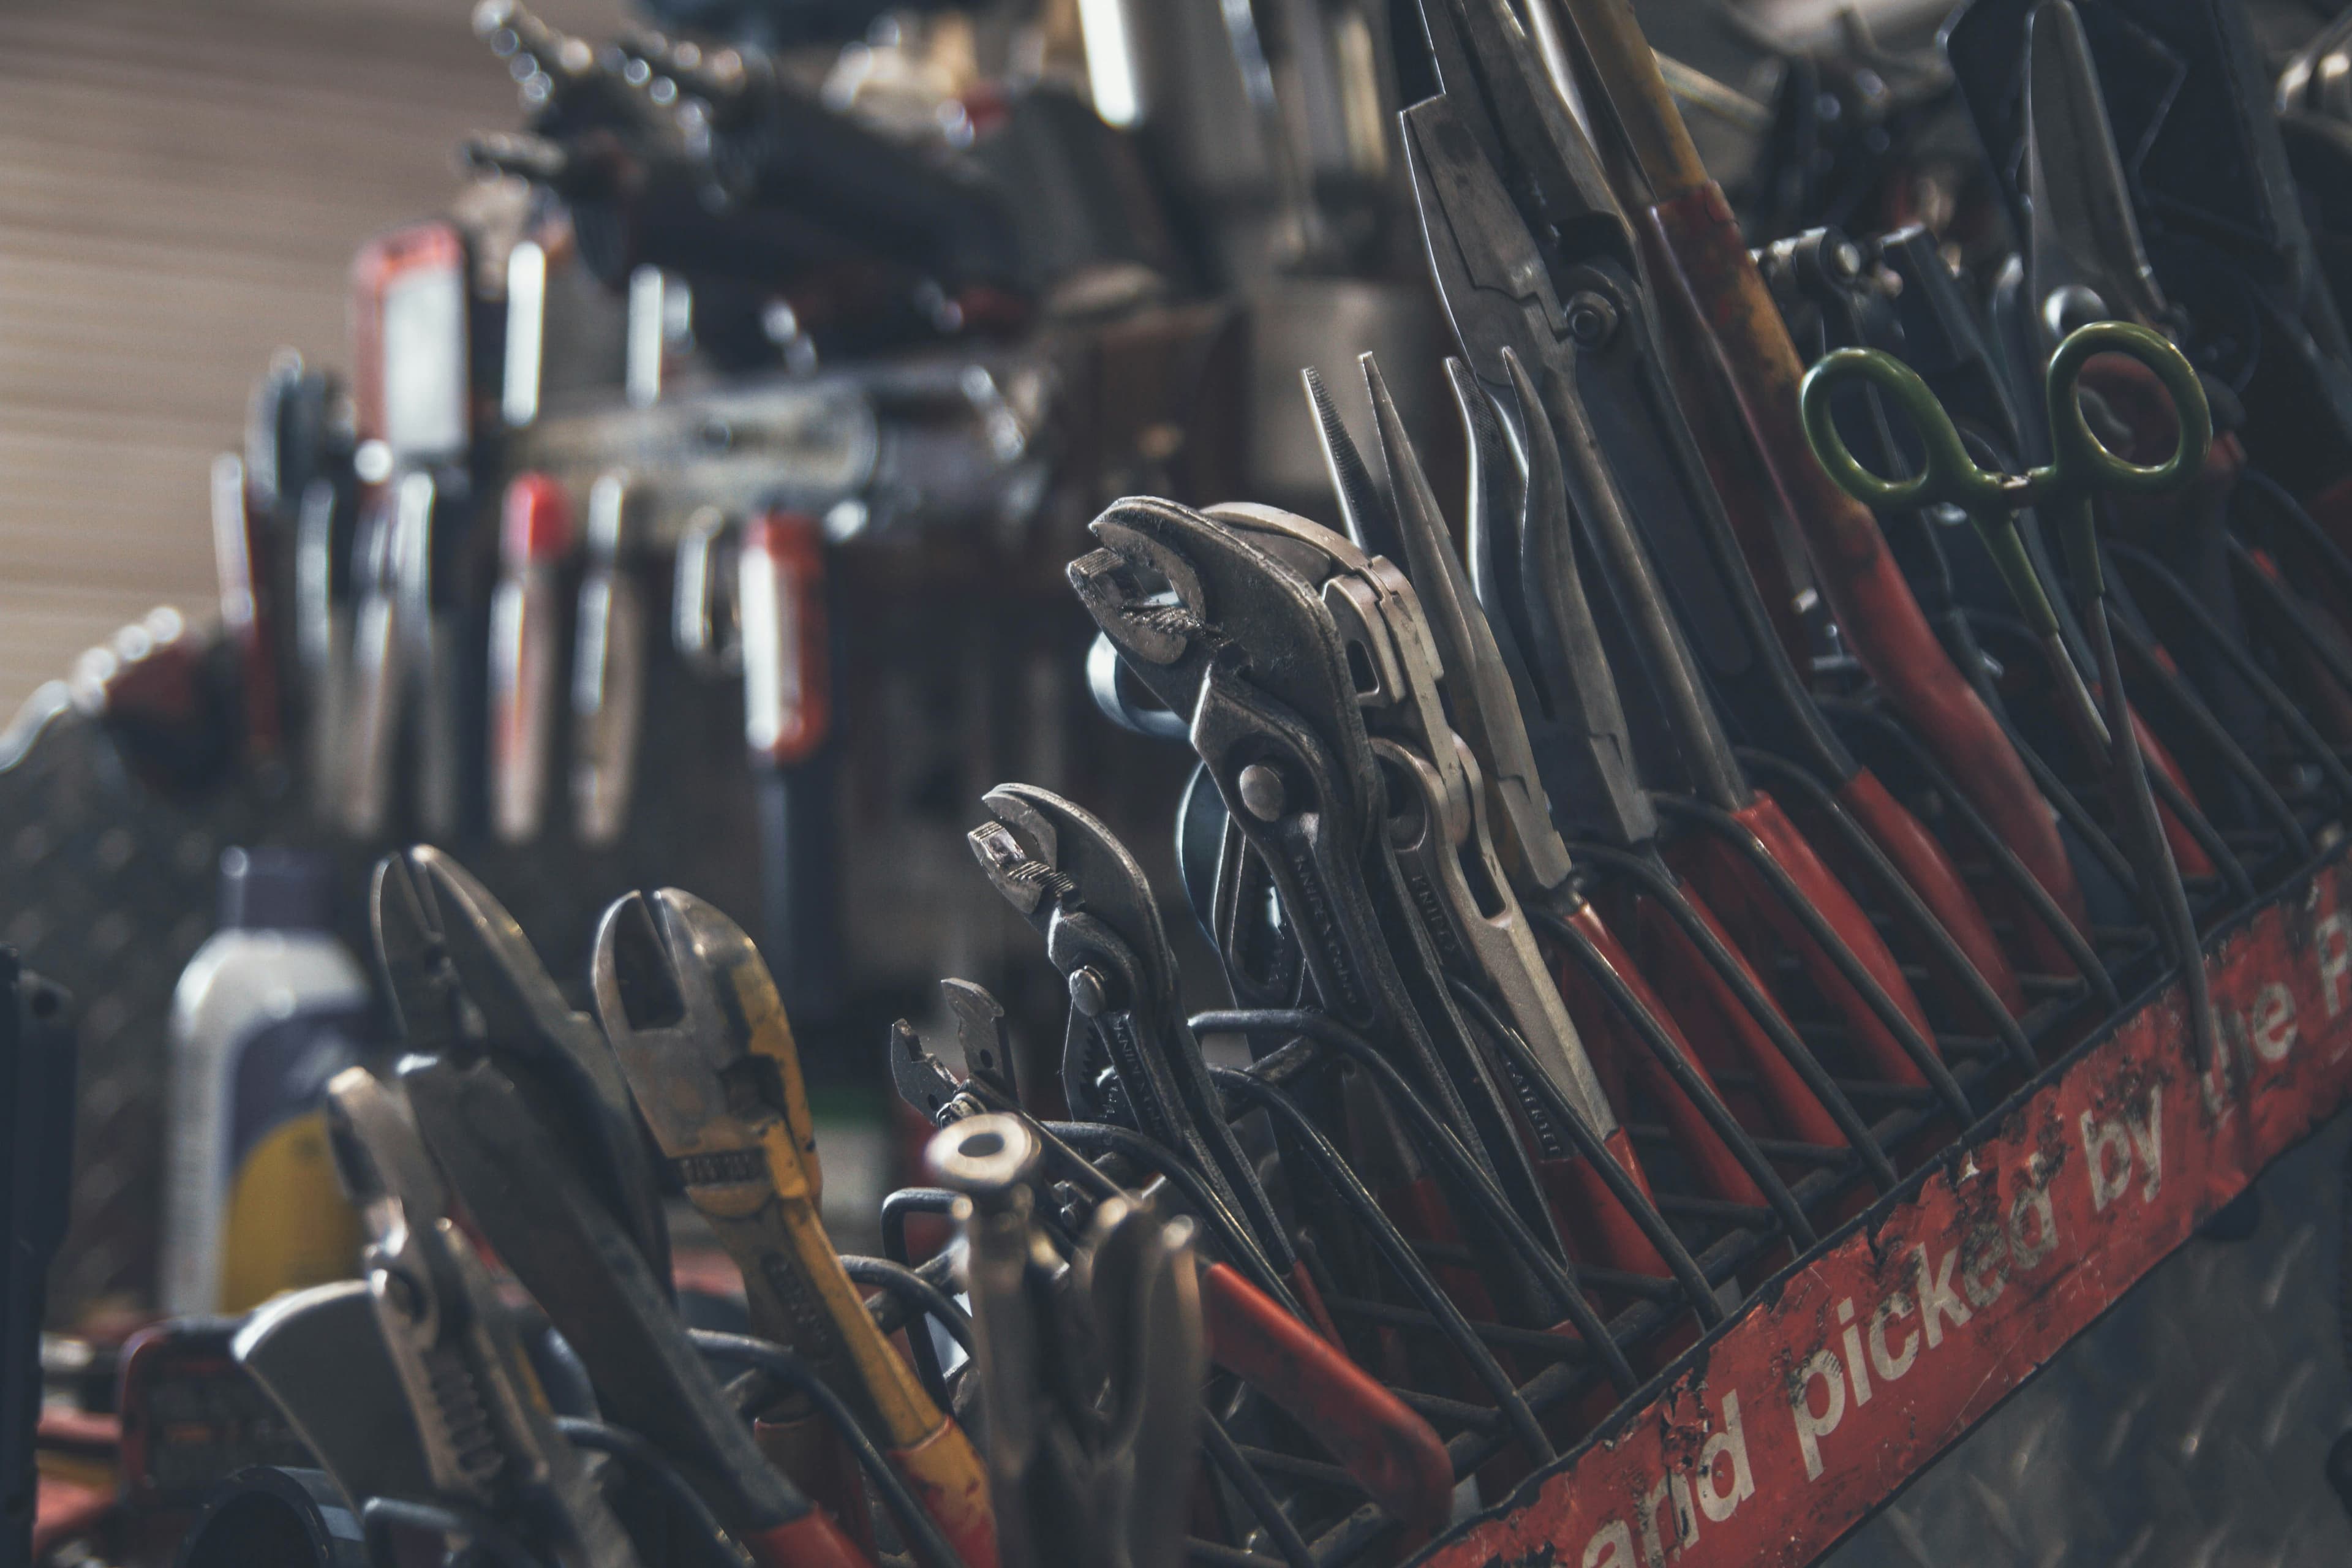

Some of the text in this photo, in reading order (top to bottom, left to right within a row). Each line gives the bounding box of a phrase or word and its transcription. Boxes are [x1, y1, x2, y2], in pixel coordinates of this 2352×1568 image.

[1582, 1389, 1755, 1568] and
[1789, 1152, 2059, 1482] picked
[2081, 1085, 2163, 1212] by
